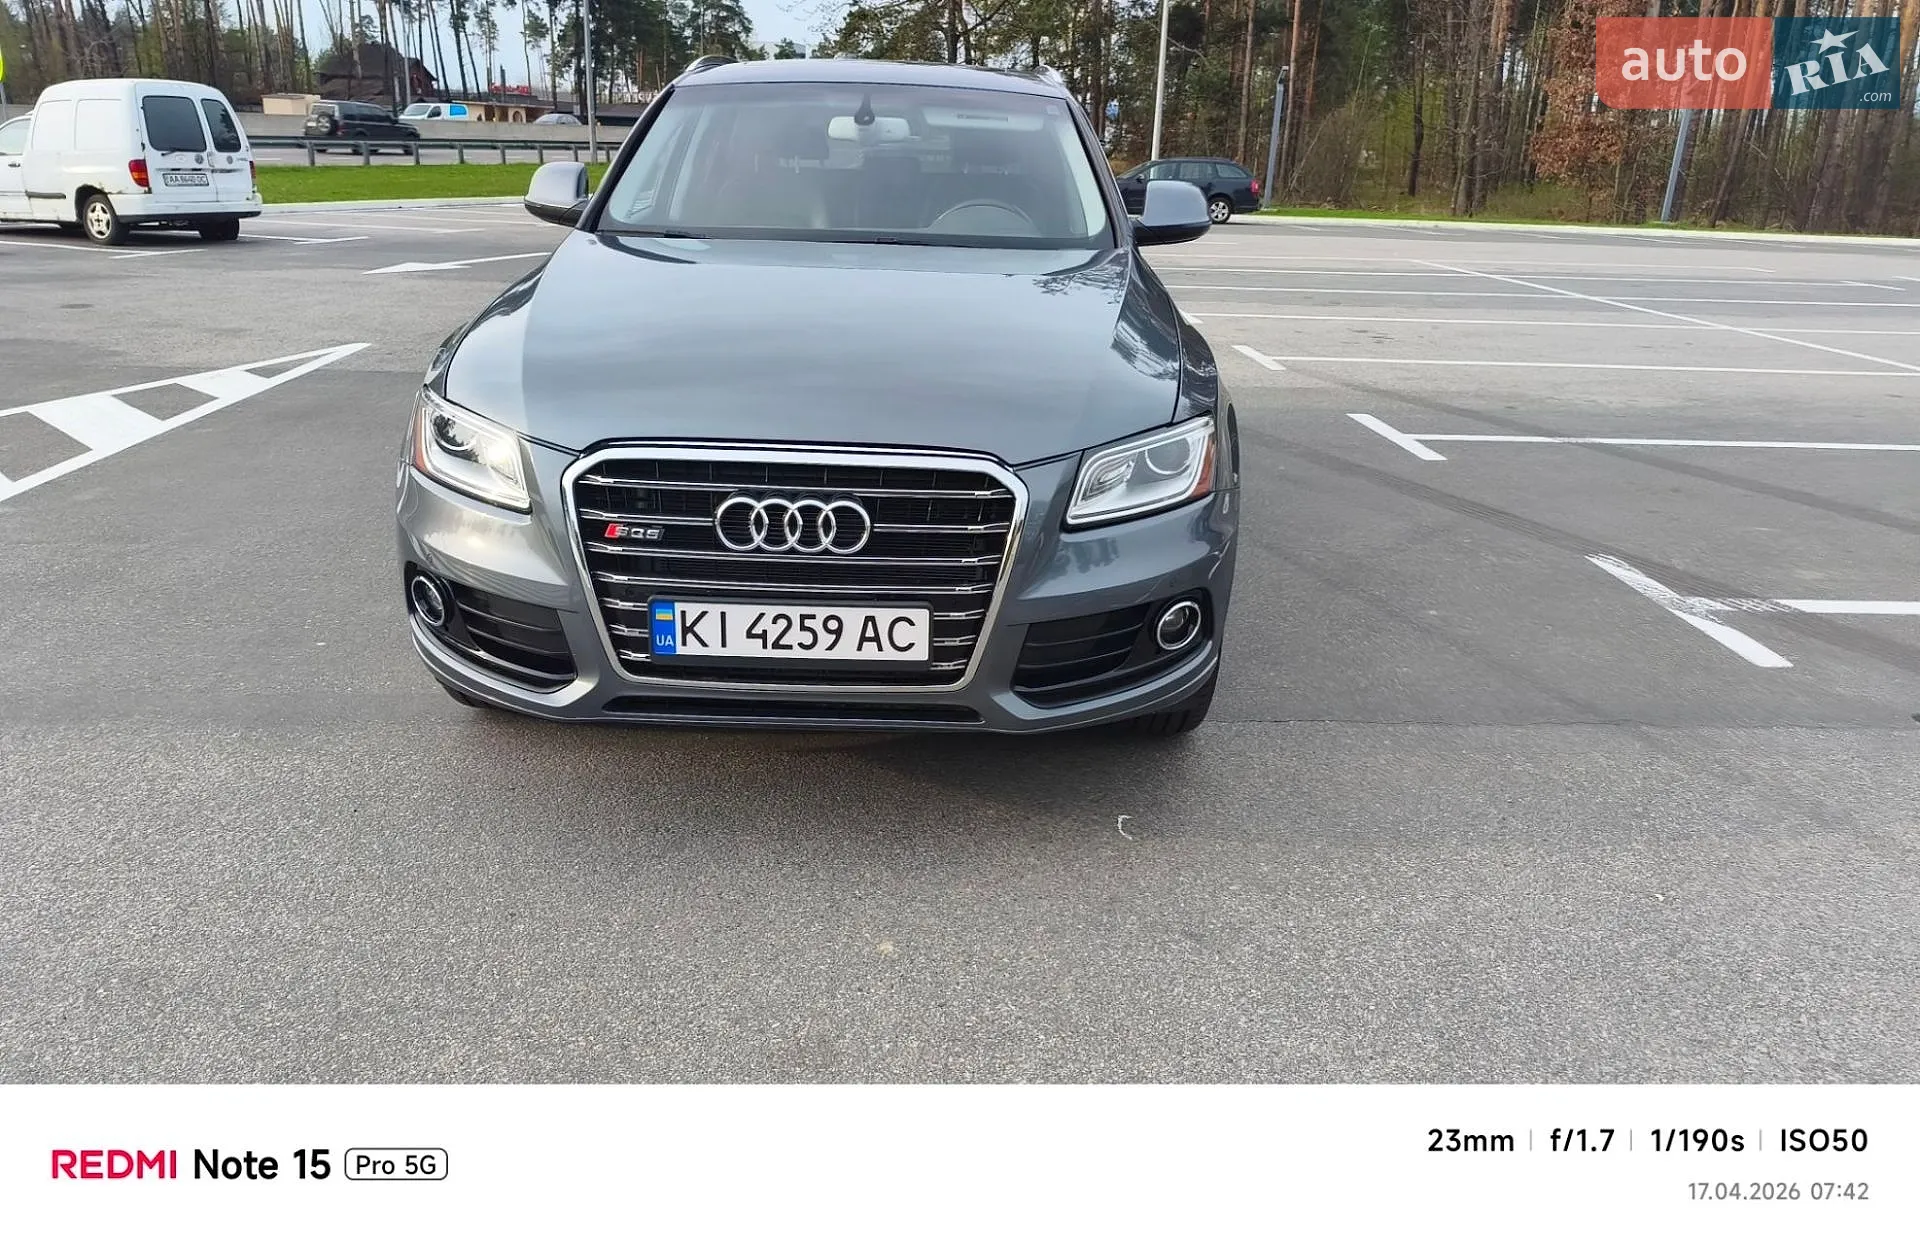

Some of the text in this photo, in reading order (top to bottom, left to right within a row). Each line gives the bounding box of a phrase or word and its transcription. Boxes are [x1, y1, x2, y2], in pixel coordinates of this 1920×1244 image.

[656, 633, 675, 647] UA
[680, 610, 916, 653] KI 4259 AC
